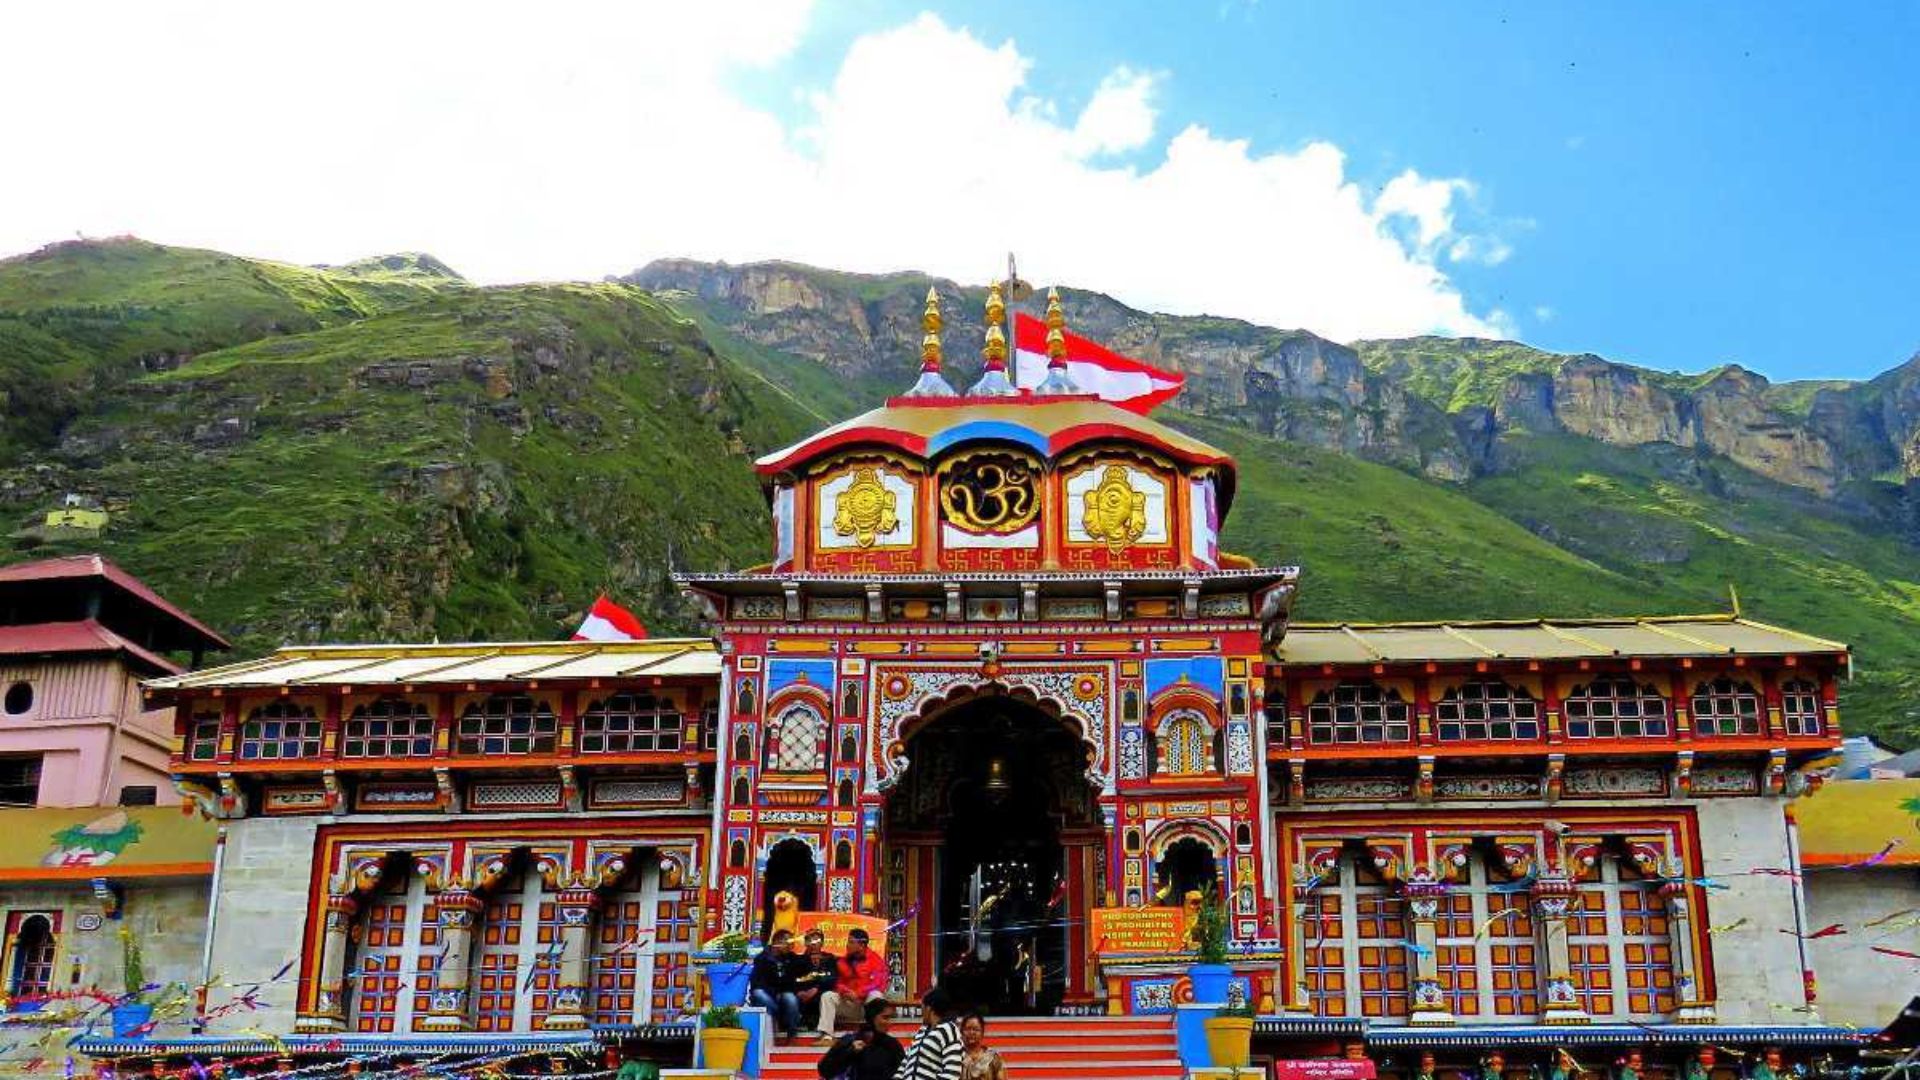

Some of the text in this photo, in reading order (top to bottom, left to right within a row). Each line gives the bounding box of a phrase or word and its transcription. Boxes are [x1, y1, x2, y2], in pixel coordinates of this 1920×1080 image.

[1102, 912, 1174, 920] PHOTOGRAPHY
[1103, 921, 1174, 930] IS PROHIBITED
[1101, 931, 1134, 940] INSIDE
